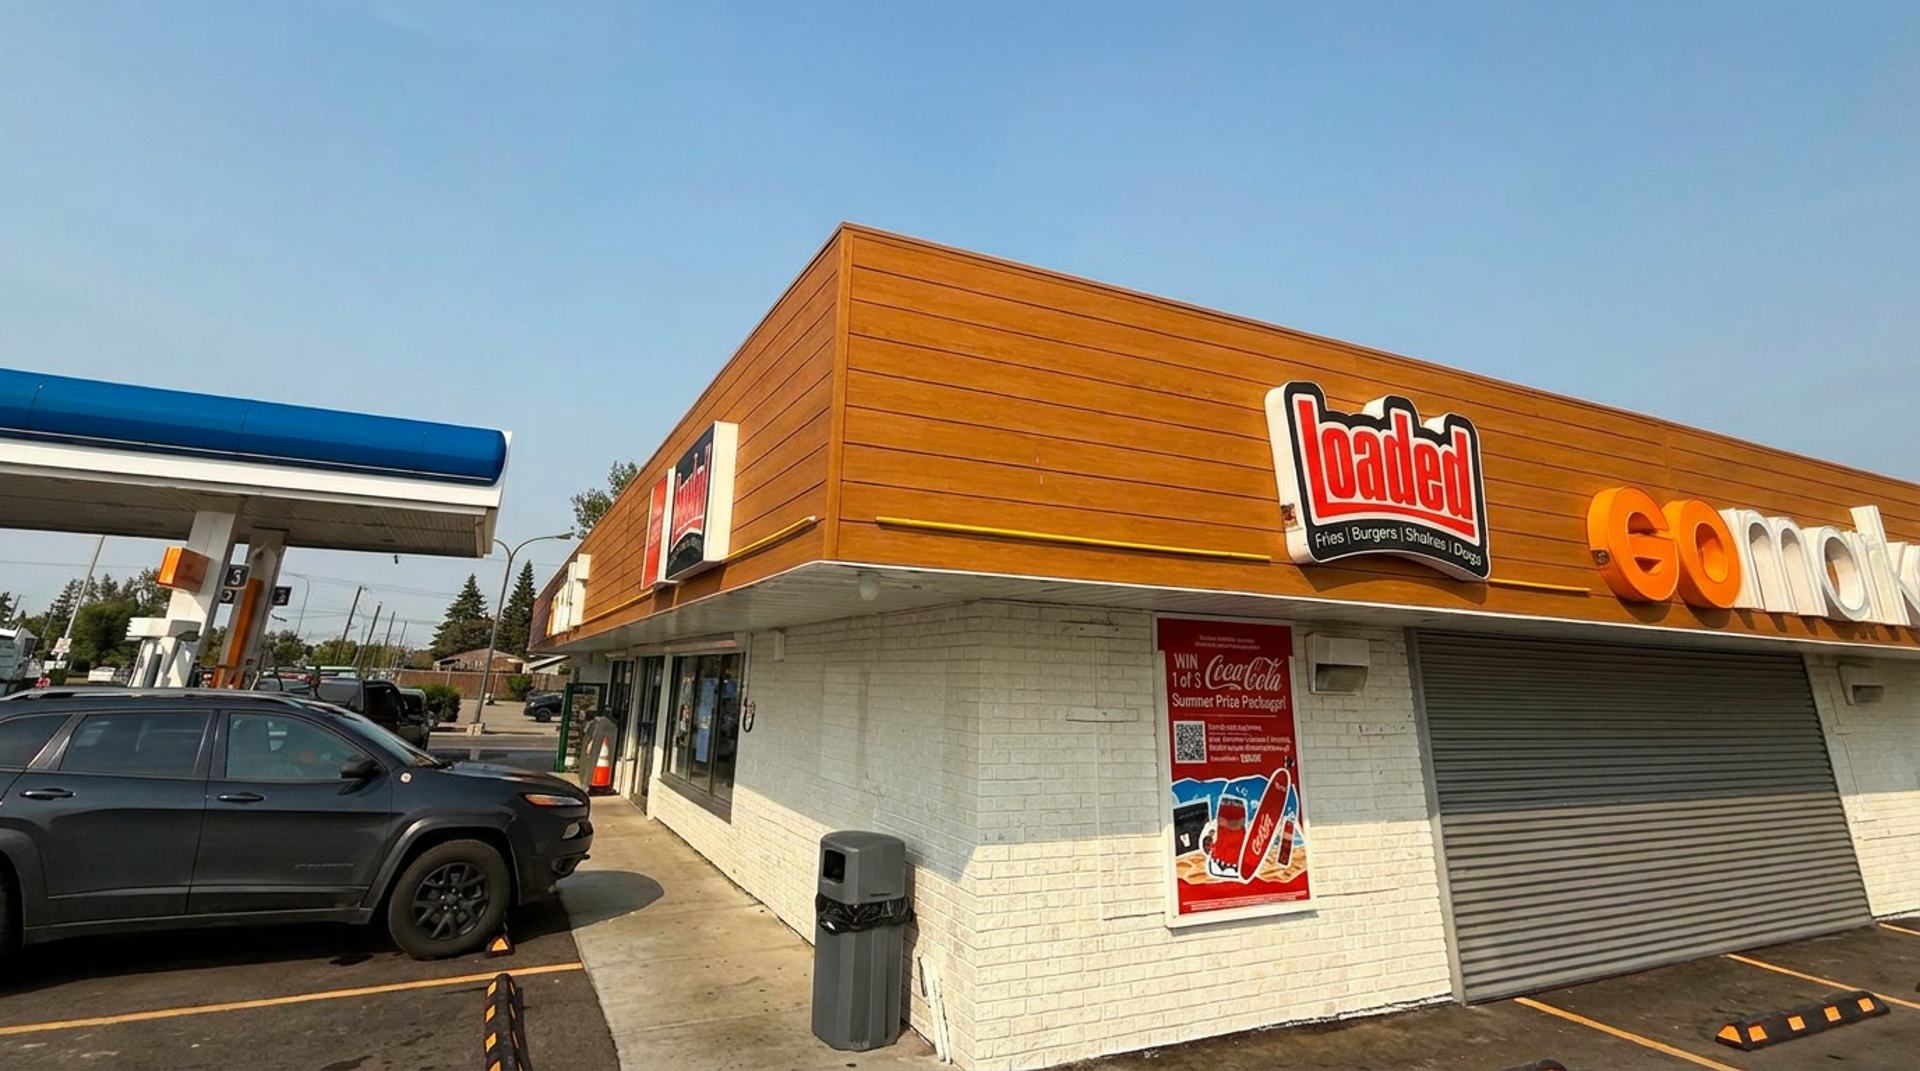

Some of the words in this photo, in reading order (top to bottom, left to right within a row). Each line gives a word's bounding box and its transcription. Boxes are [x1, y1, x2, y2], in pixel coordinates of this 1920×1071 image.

[1315, 532, 1345, 549] Fries
[1351, 526, 1398, 542] Burgers
[1173, 653, 1198, 670] WIN
[1172, 692, 1214, 708] Summer
